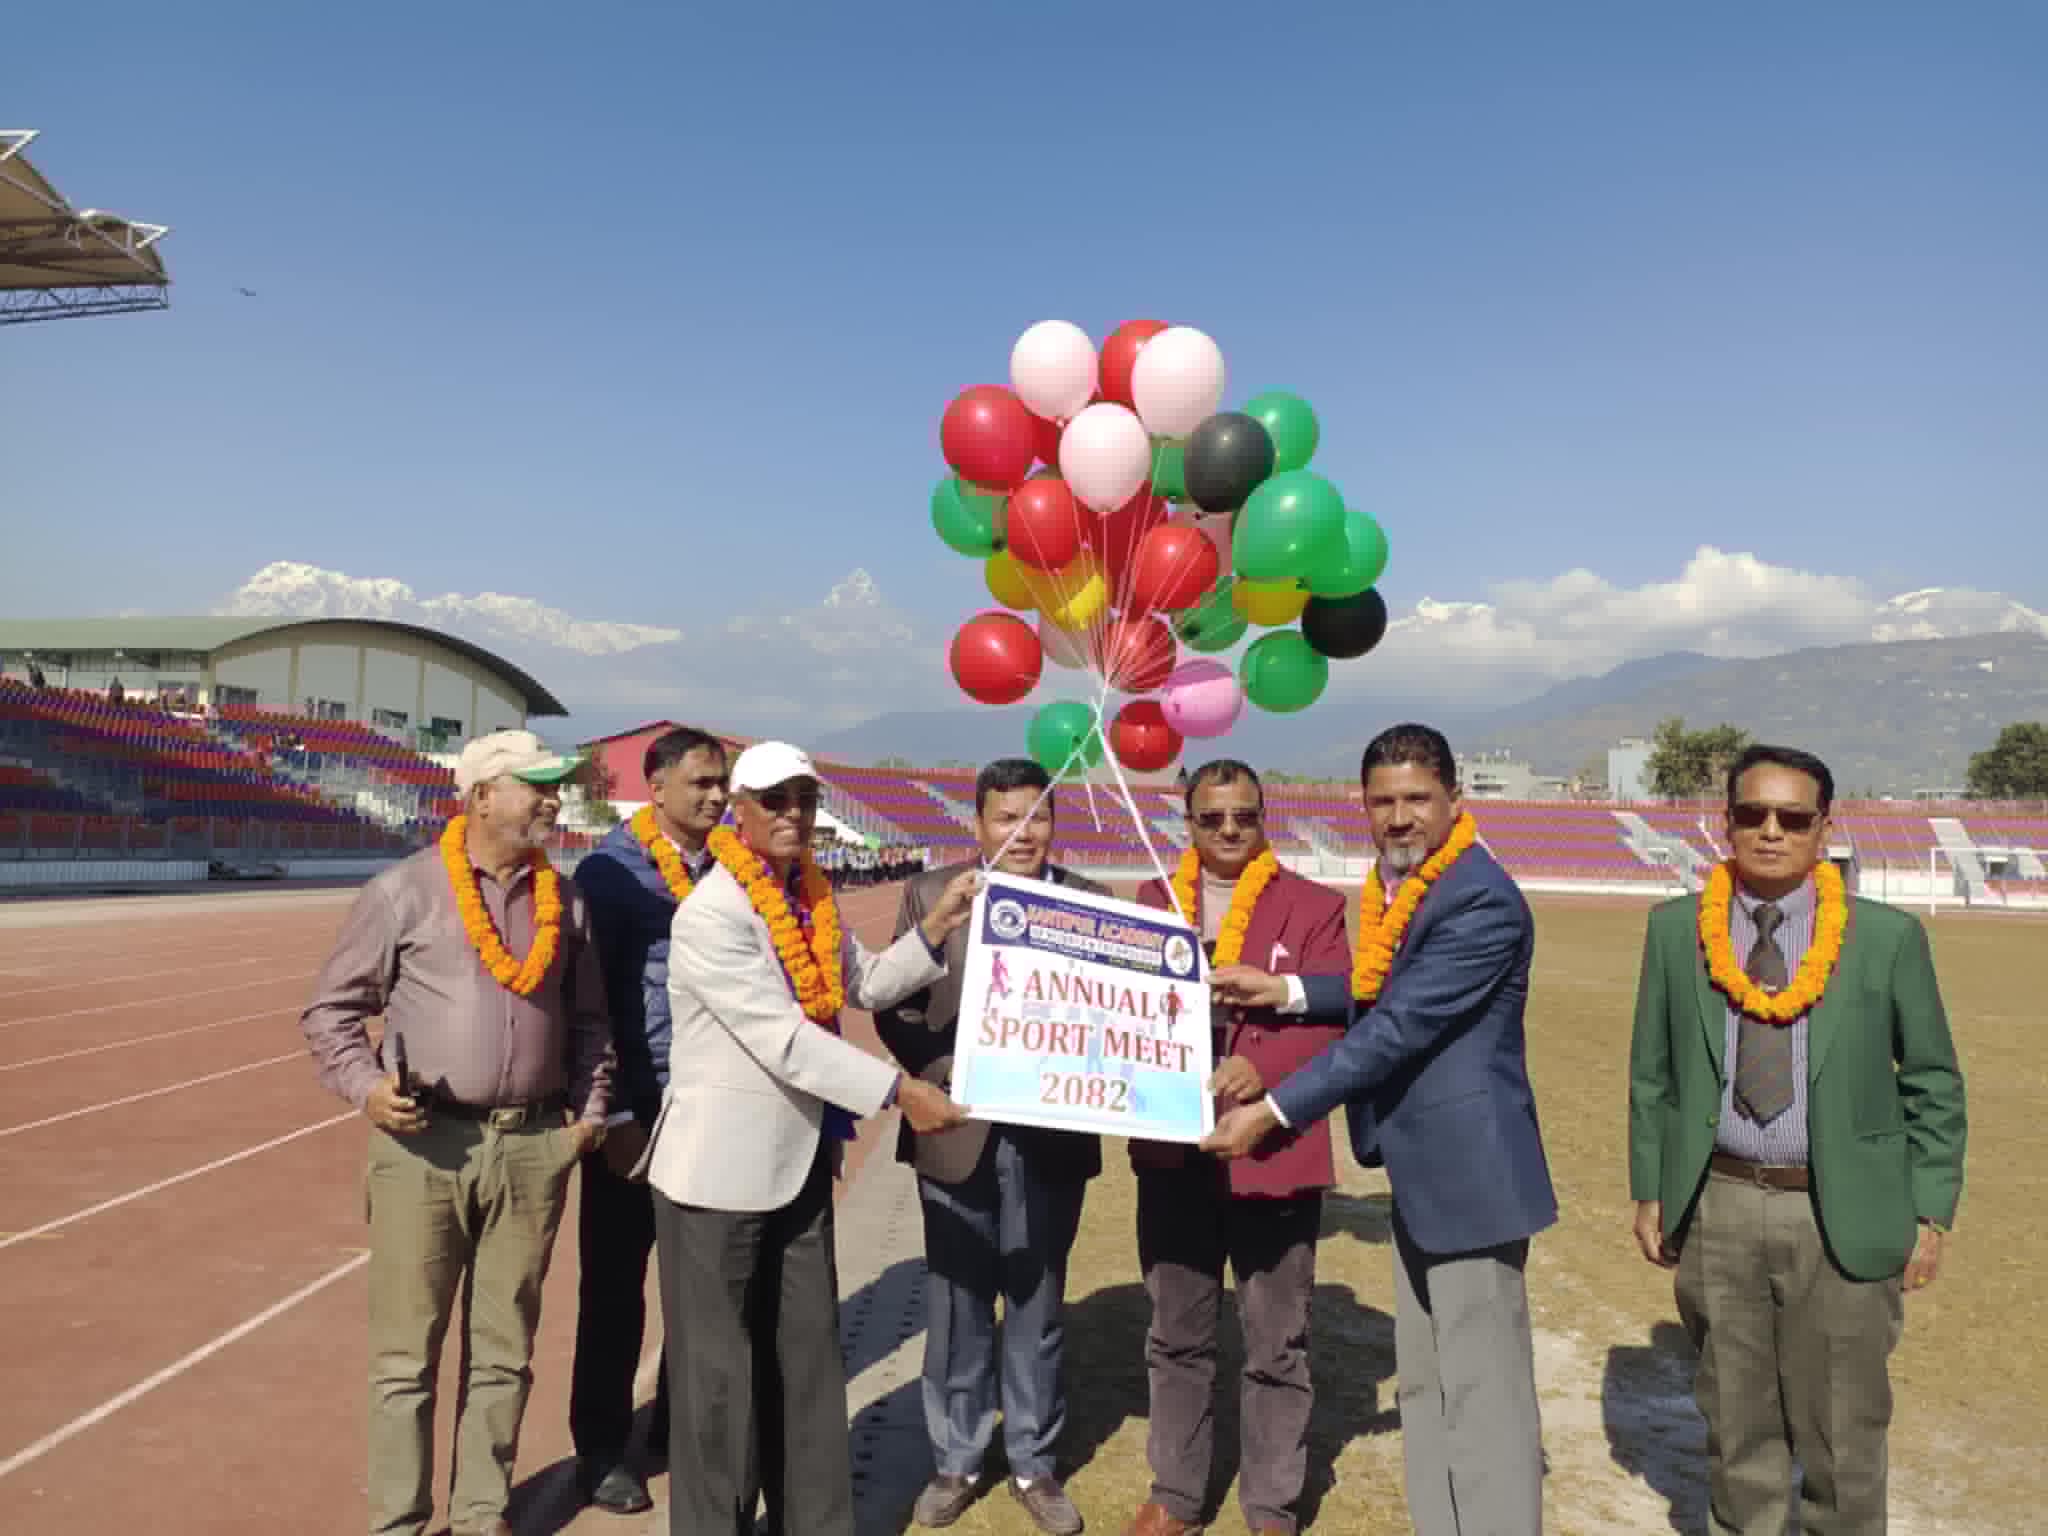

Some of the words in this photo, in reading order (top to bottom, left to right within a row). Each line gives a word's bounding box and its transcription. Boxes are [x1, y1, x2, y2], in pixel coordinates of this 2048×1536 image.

[1024, 968, 1157, 1021] ANNUAL
[979, 1014, 1094, 1057] SPORT
[1104, 1027, 1193, 1073] MEET
[1041, 1072, 1127, 1112] 2082
